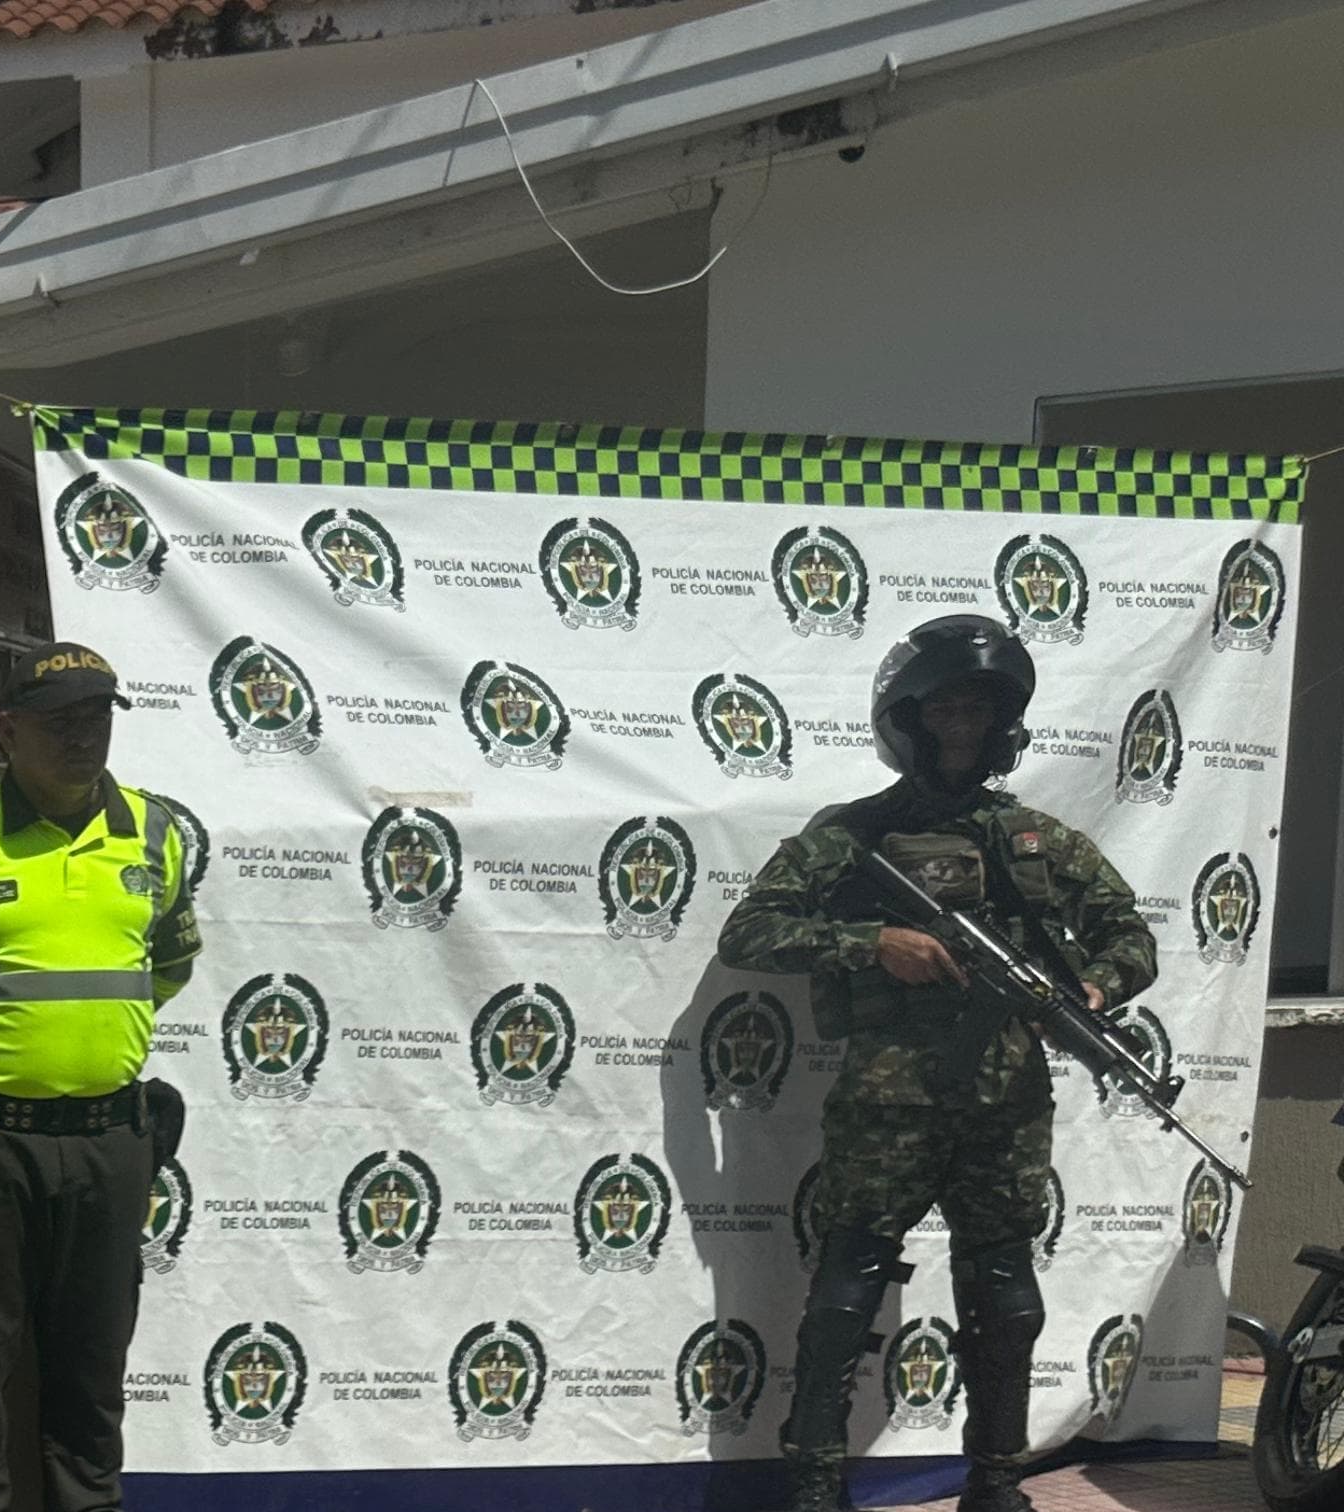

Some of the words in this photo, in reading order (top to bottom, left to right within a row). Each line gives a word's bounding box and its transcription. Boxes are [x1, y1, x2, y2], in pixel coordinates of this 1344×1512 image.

[232, 535, 300, 551] NACIONAL
[190, 551, 207, 563] DE
[211, 549, 288, 564] COLOMBIA
[471, 562, 536, 575] NACIONAL
[707, 568, 769, 582] NACIONAL
[435, 576, 451, 587] DE
[456, 575, 522, 589] COLOMBIA
[670, 582, 687, 595] DE
[690, 583, 755, 596] COLOMBIA
[930, 576, 992, 590] NACIONAL
[1147, 582, 1209, 595] NACIONAL
[897, 590, 913, 602] DE
[917, 590, 979, 604] COLOMBIA
[1116, 596, 1132, 608] DE
[1135, 596, 1195, 609] COLOMBIA
[126, 681, 197, 696] NACIONAL
[131, 697, 181, 710] LOMBIA
[384, 699, 451, 713] NACIONAL
[347, 711, 364, 724] DE
[368, 713, 437, 727] COLOMBIA
[620, 711, 685, 727] NACIONAL
[591, 722, 608, 735] DE
[611, 723, 673, 739] COLOMBIA
[1033, 743, 1047, 754] DE
[282, 849, 351, 865] NACIONAL
[239, 865, 256, 878] DE
[261, 865, 332, 880] COLOMBIA
[531, 862, 595, 876] NACIONAL
[489, 877, 506, 890] DE
[510, 878, 577, 893] COLOMBIA
[398, 1030, 461, 1043] NACIONAL
[633, 1037, 692, 1051] NACIONAL
[358, 1045, 374, 1058] DE
[378, 1046, 442, 1060] COLOMBIA
[595, 1052, 611, 1064] DE
[615, 1053, 674, 1066] COLOMBIA
[265, 1200, 328, 1213] NACIONAL
[509, 1203, 570, 1216] NACIONAL
[734, 1205, 788, 1217] NACIONAL
[220, 1218, 238, 1230] DE
[242, 1217, 310, 1230] COLOMBIA
[469, 1219, 485, 1231] DE
[490, 1219, 552, 1231] COLOMBIA
[694, 1220, 709, 1232] DE
[714, 1220, 773, 1232] COLOMBIA
[374, 1371, 438, 1384] NACIONAL
[604, 1369, 666, 1382] NACIONAL
[334, 1389, 350, 1401] DE
[354, 1388, 422, 1401] COLOMBIA
[566, 1385, 582, 1397] DE
[587, 1384, 651, 1398] COLOMBIA
